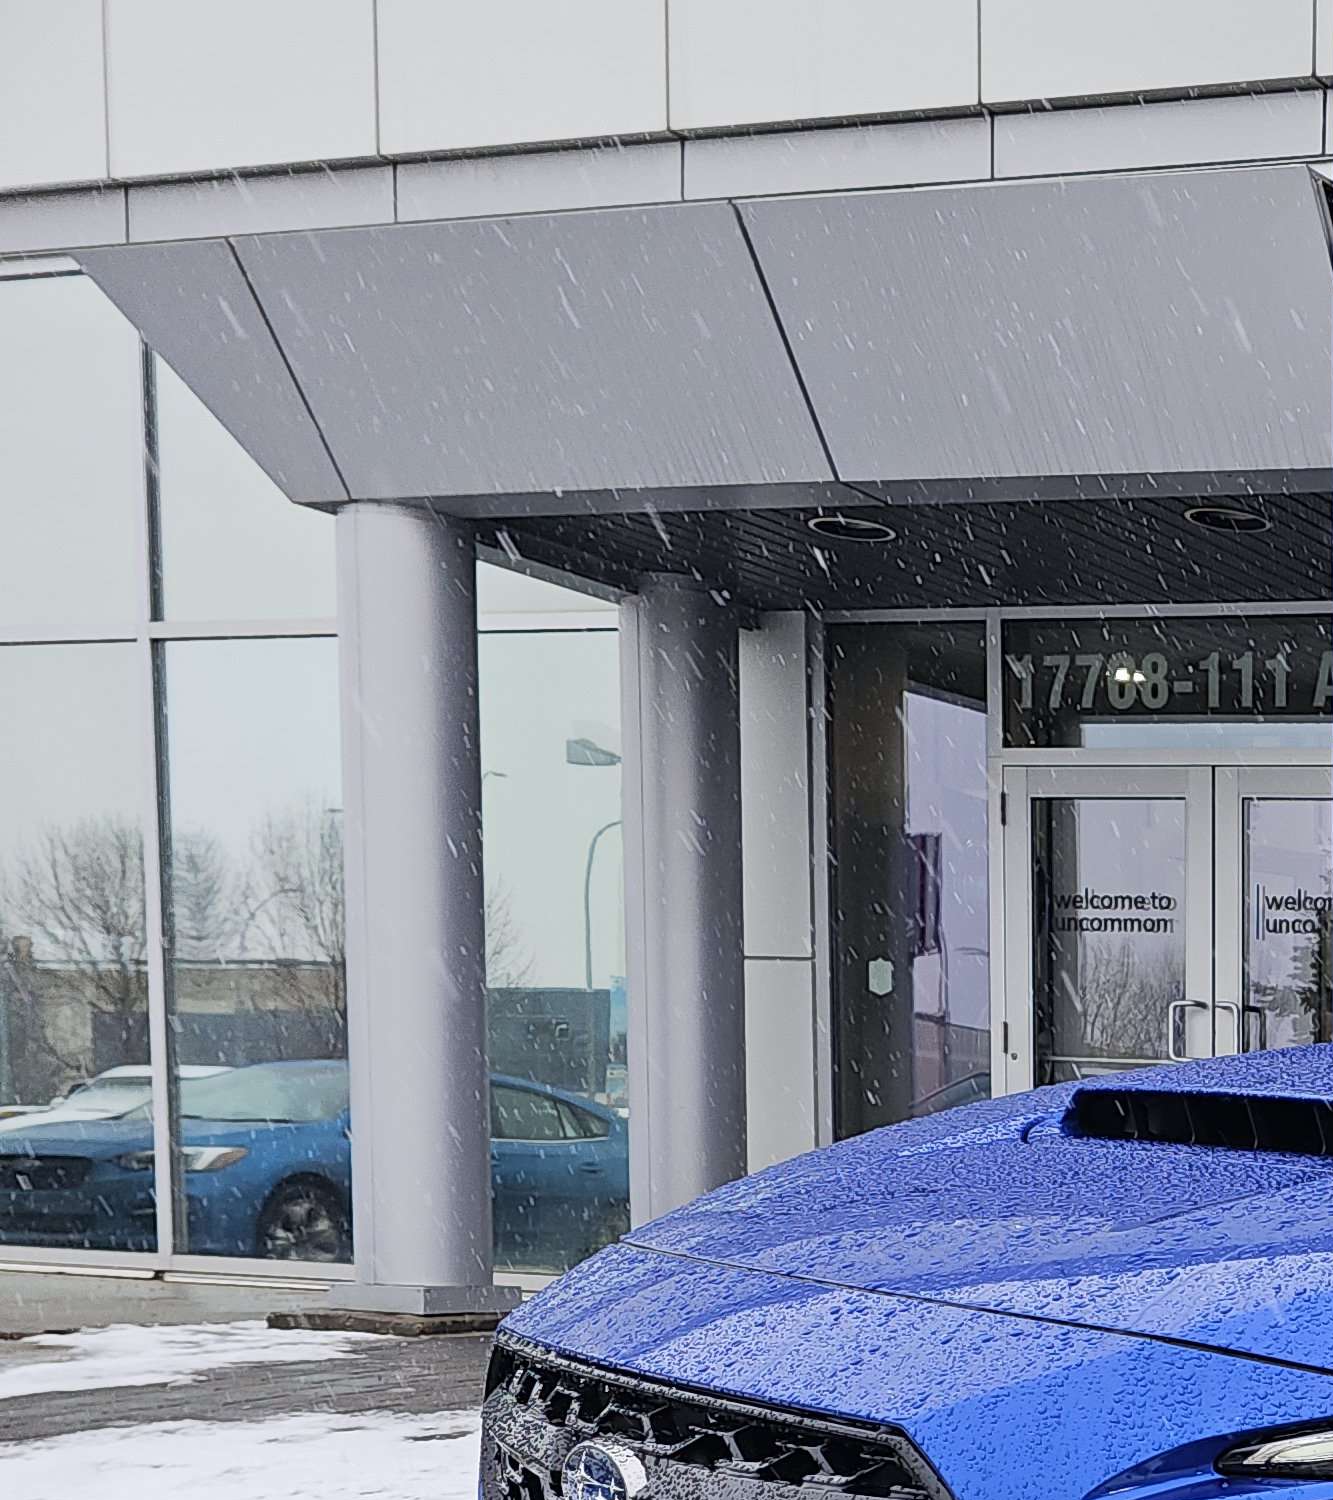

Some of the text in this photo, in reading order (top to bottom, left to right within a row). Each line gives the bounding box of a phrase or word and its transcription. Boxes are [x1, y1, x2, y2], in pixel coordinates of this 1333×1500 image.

[1055, 887, 1174, 911] welcome to
[1055, 916, 1171, 934] uncommon
